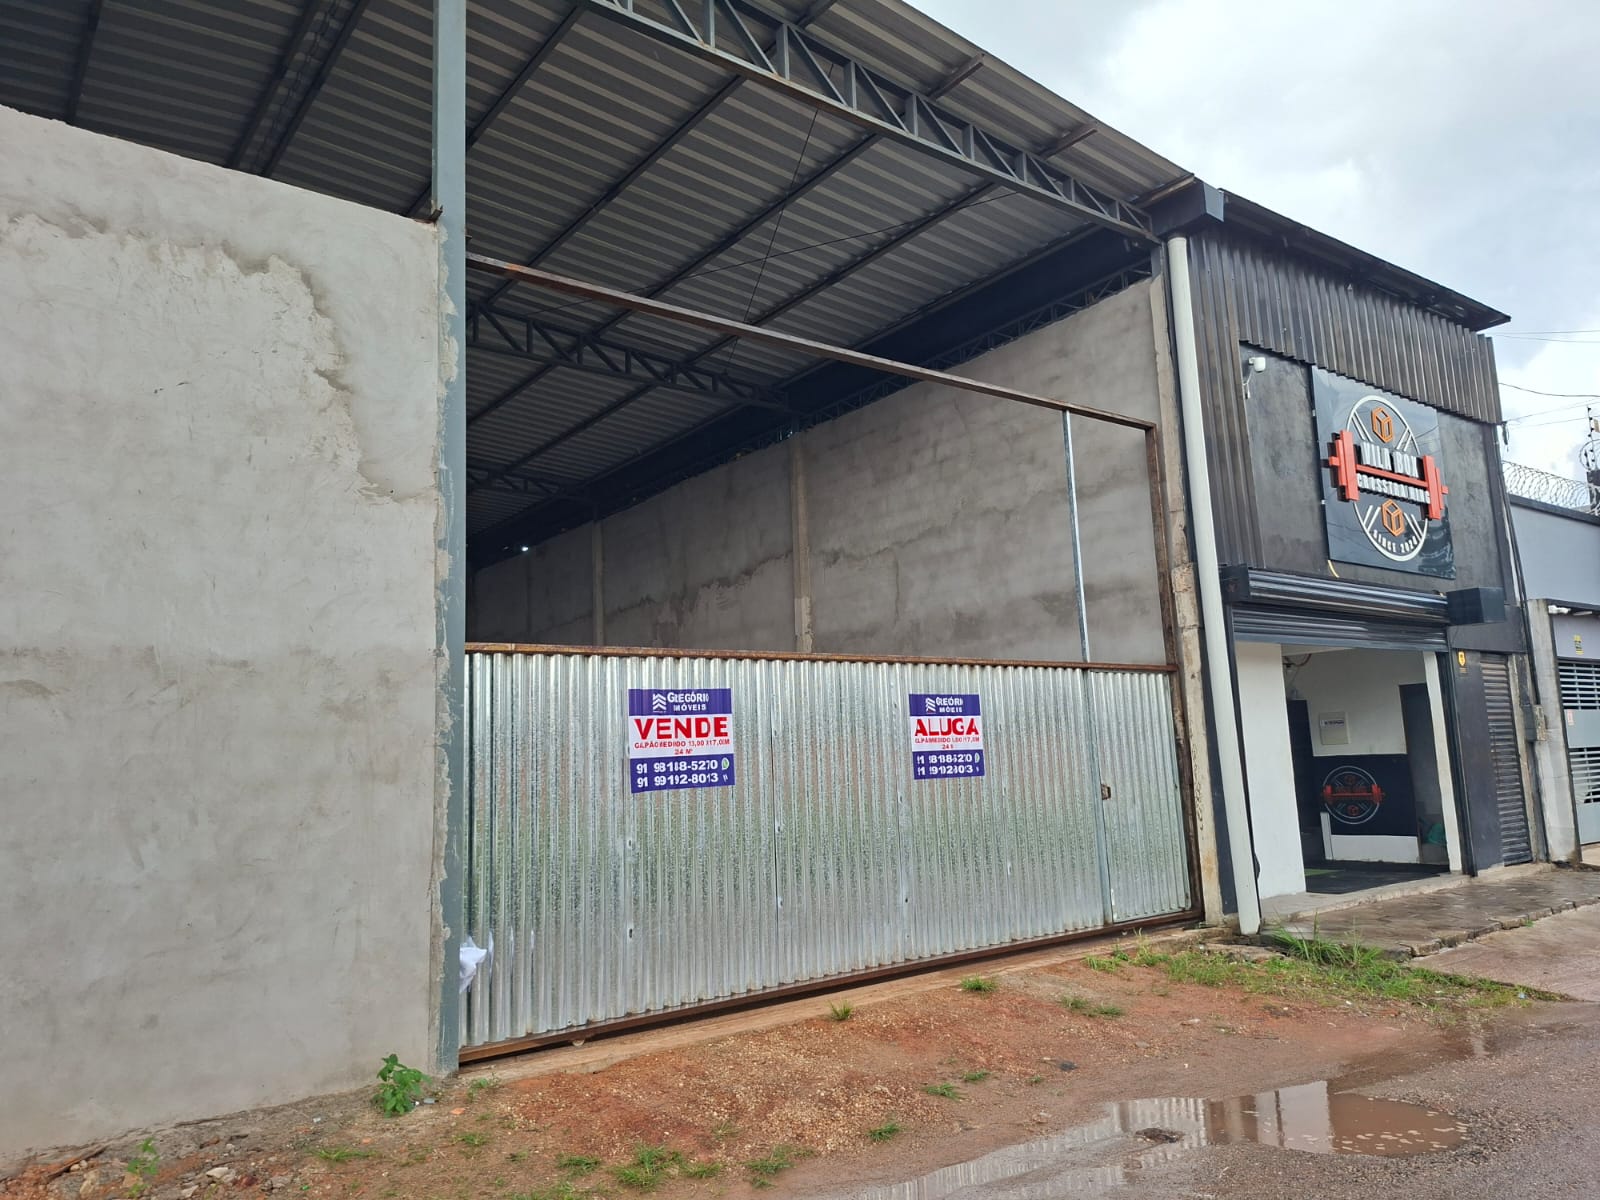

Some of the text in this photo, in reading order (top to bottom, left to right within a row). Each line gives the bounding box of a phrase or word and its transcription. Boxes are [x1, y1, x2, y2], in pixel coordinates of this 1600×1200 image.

[1360, 442, 1419, 478] VILA BOX
[634, 717, 728, 740] VENDE
[914, 718, 979, 736] ALUGA
[636, 763, 647, 774] 91
[637, 777, 648, 787] 91
